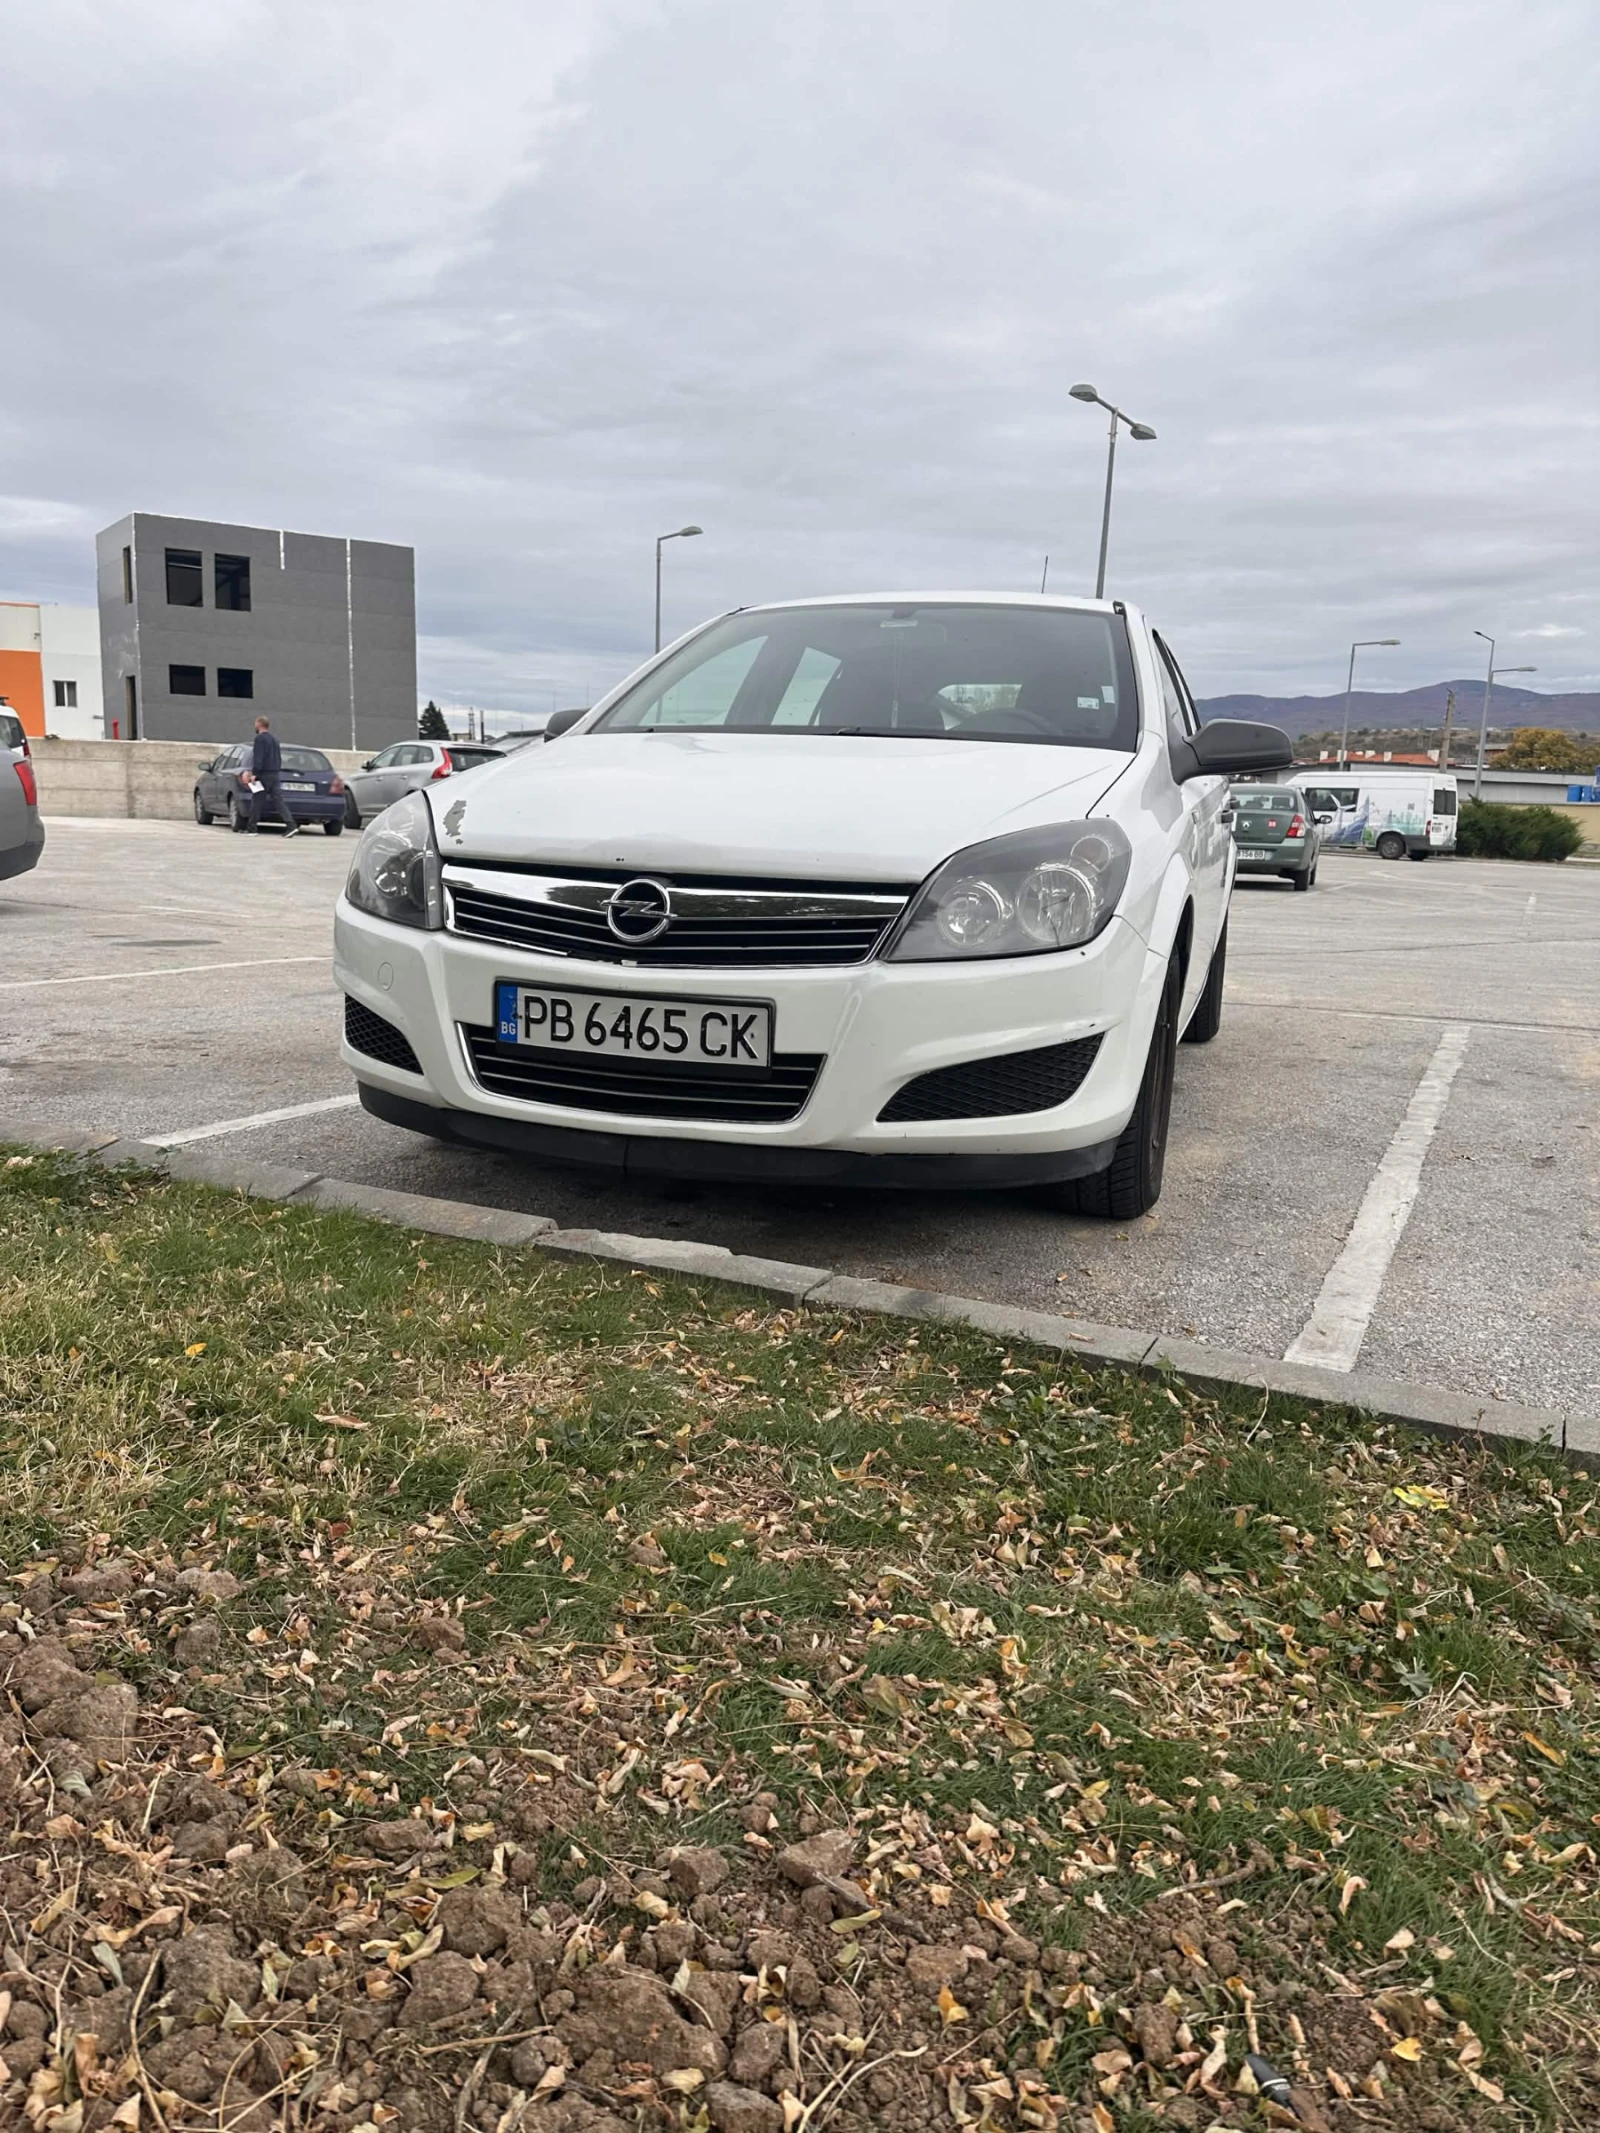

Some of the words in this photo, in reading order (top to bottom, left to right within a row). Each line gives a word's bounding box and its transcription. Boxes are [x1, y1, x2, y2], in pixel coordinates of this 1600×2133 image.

[500, 1021, 517, 1036] BG
[524, 995, 575, 1042] PB
[584, 1002, 689, 1054] 6465
[700, 1011, 758, 1060] CK
